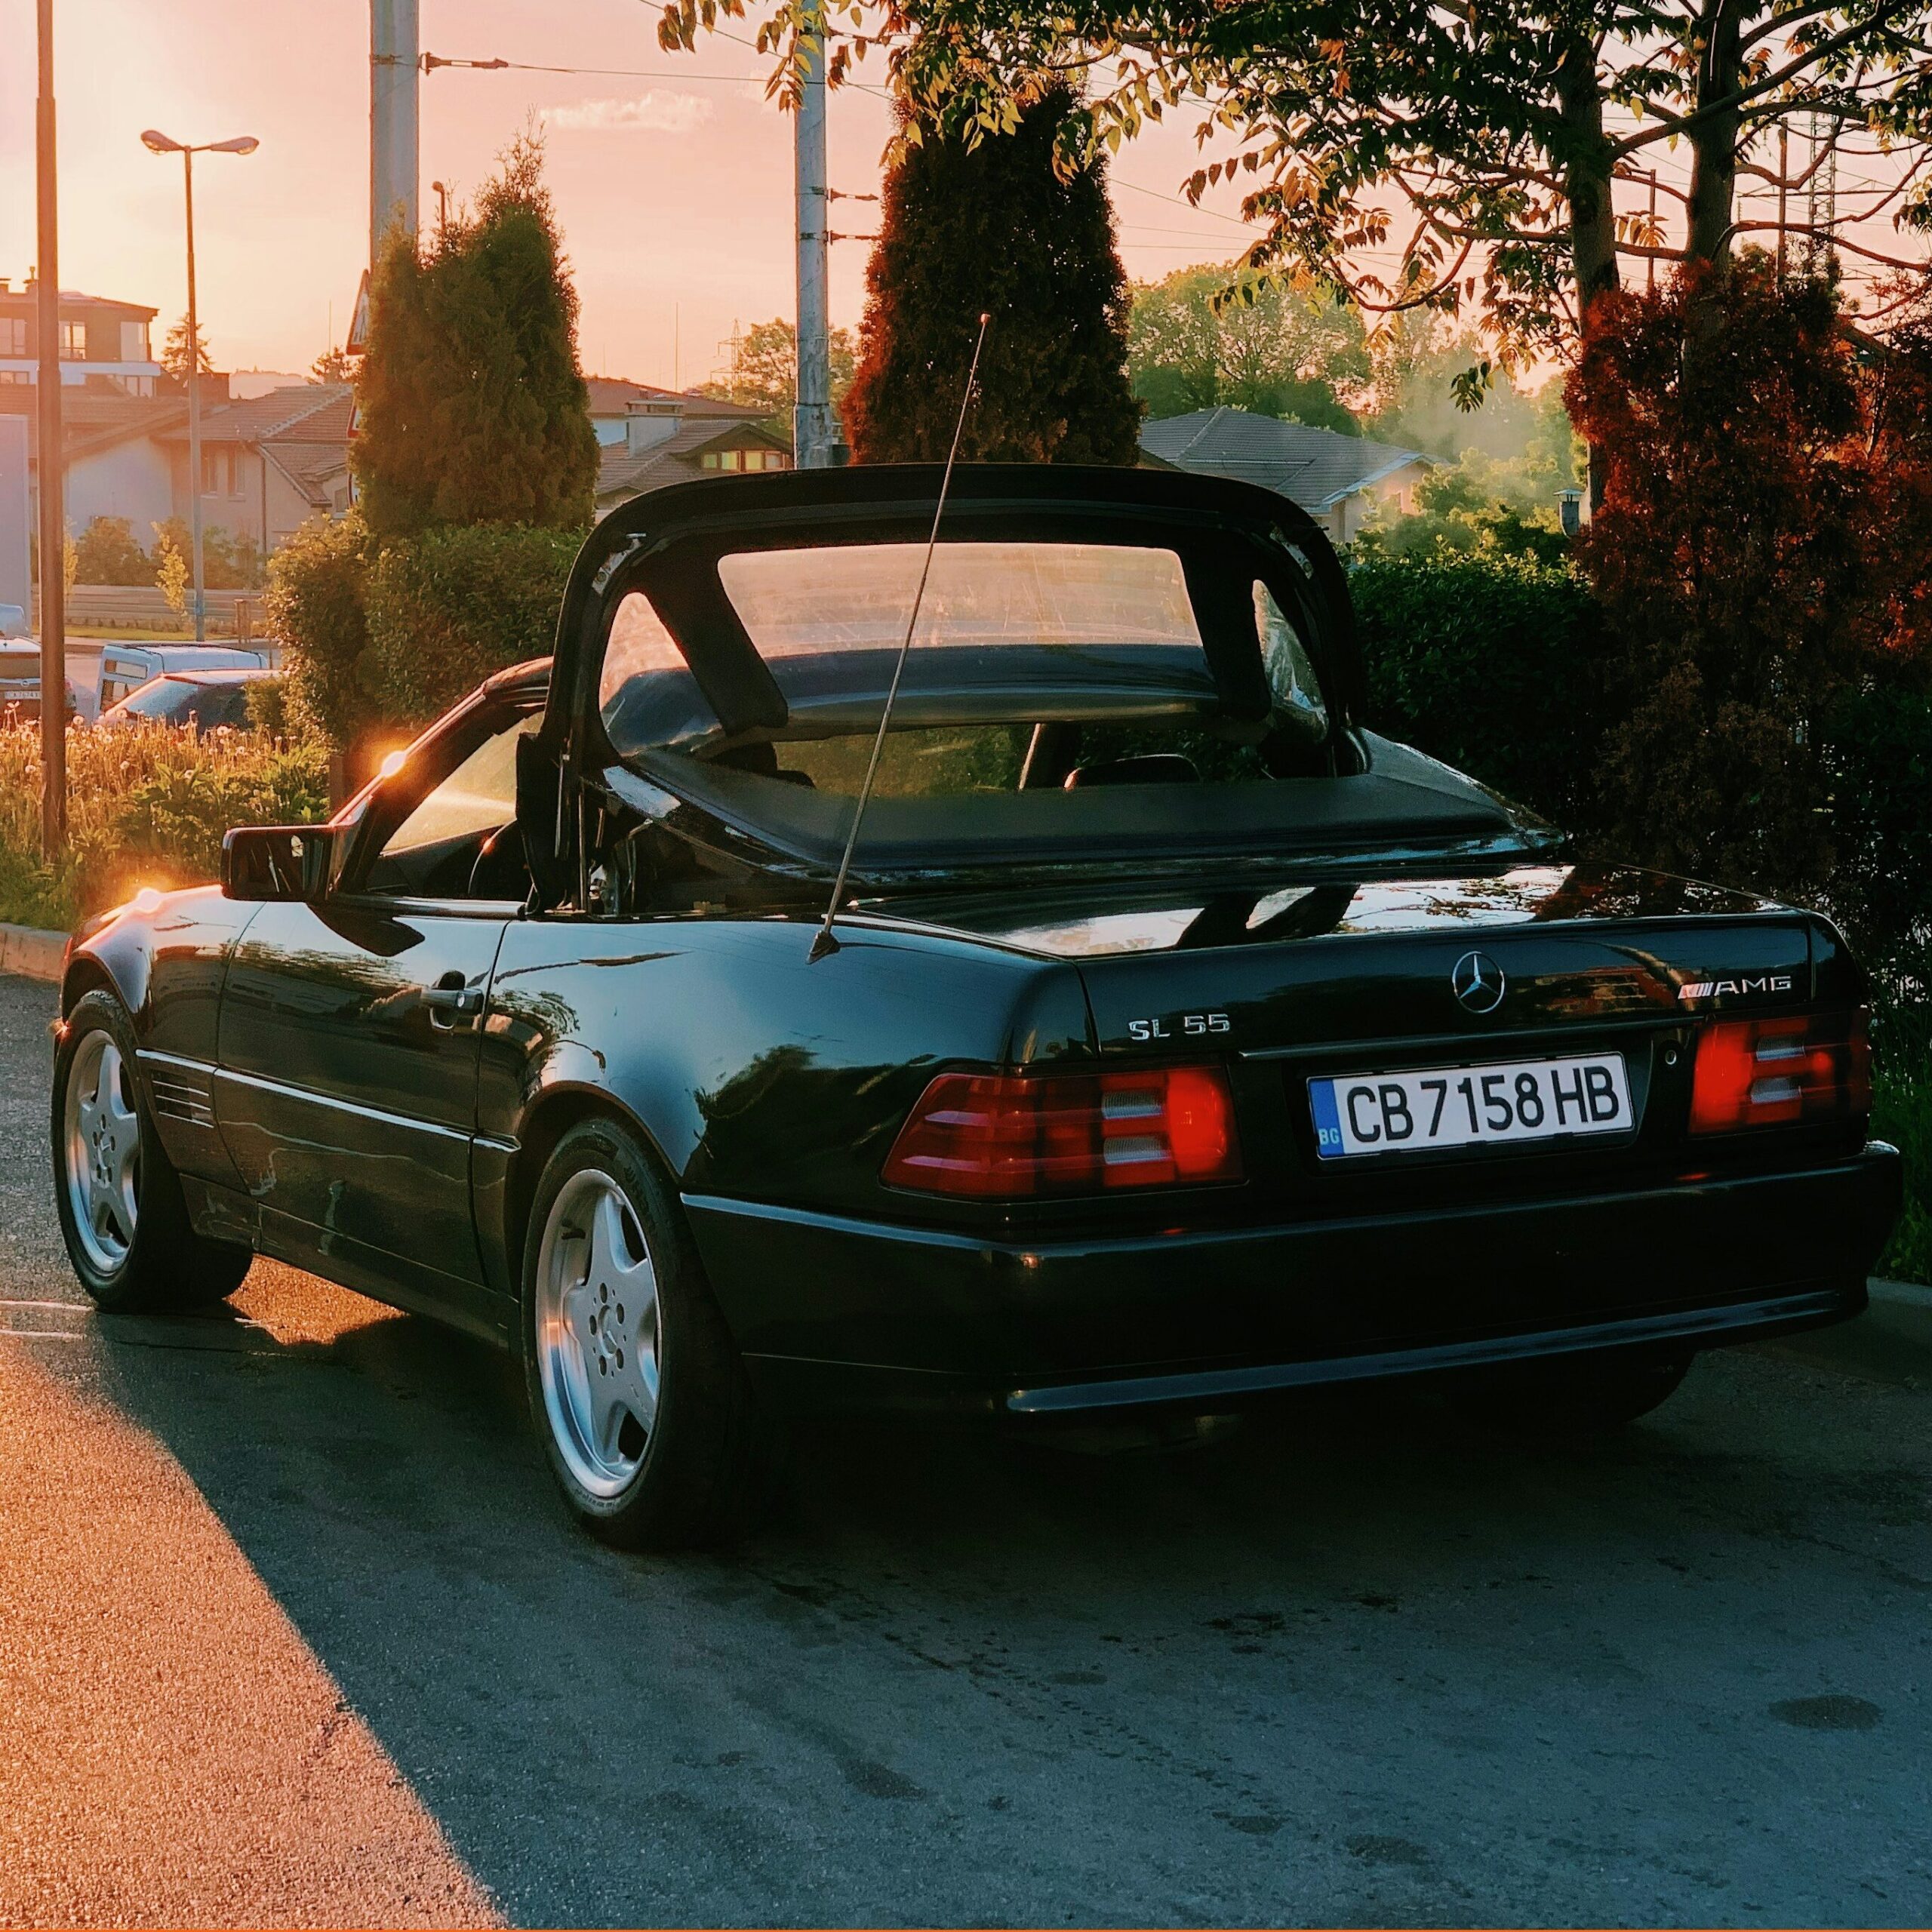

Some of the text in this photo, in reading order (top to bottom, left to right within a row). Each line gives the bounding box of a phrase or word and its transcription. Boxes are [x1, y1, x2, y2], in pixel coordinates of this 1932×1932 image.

[1714, 976, 1792, 996] AMG
[1129, 1014, 1230, 1041] SL 55
[1318, 1128, 1340, 1145] BG
